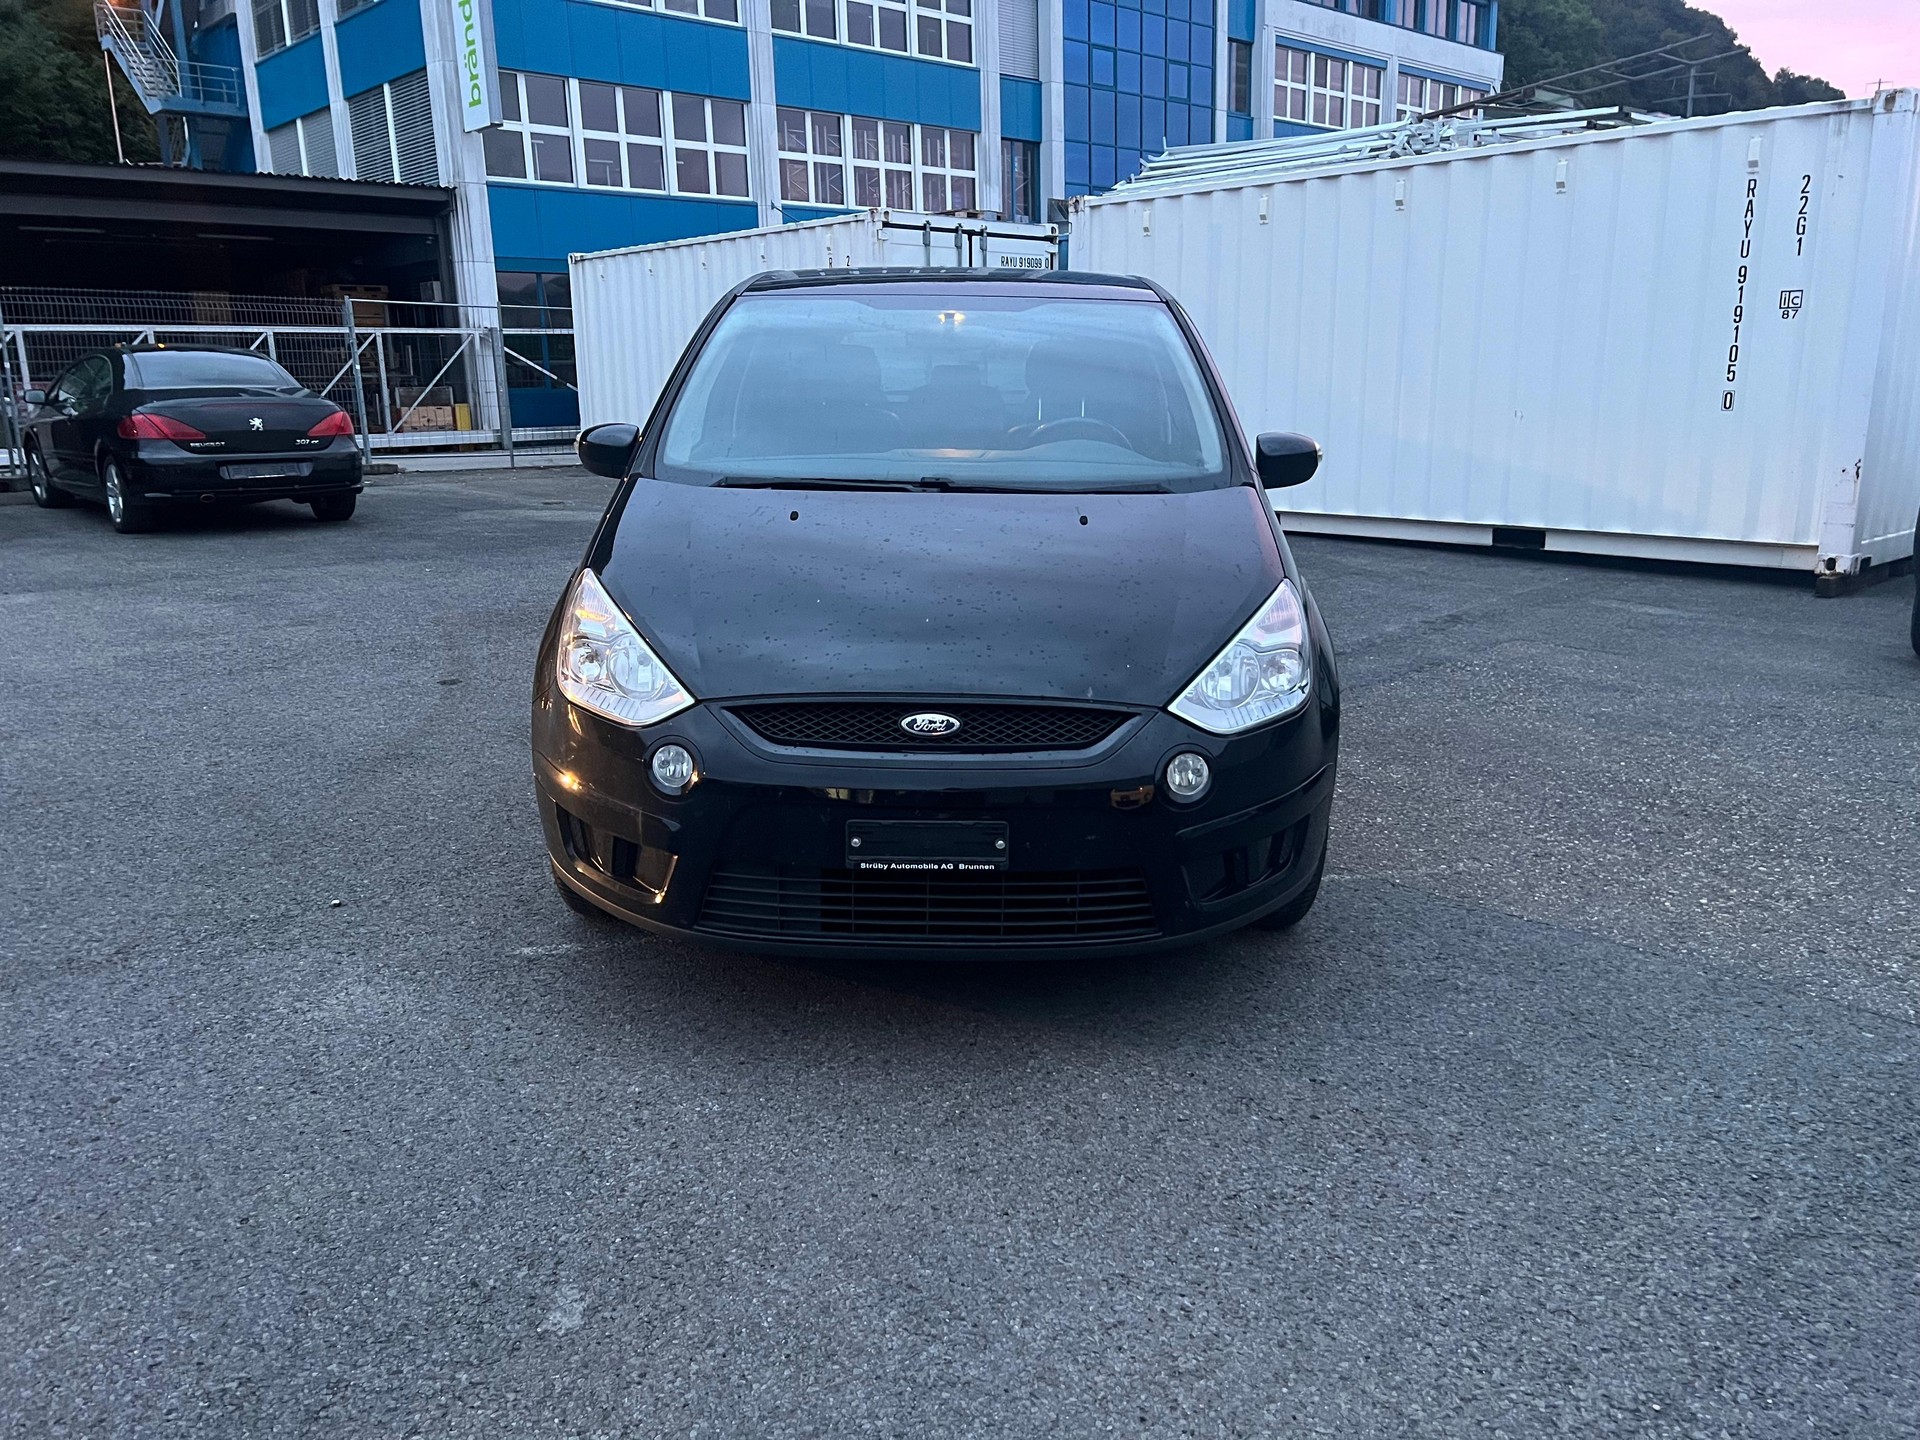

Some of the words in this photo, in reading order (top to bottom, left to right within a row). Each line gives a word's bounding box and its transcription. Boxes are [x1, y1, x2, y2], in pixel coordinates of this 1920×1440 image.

[1740, 178, 1757, 258] RAYU
[1796, 174, 1811, 256] 22G1
[1000, 256, 1018, 268] RAYU
[1019, 256, 1043, 269] 919099
[1727, 265, 1747, 382] 919105
[1781, 309, 1799, 320] 87
[1723, 391, 1734, 410] 0
[860, 862, 888, 871] Strüby
[890, 862, 939, 870] Automobile
